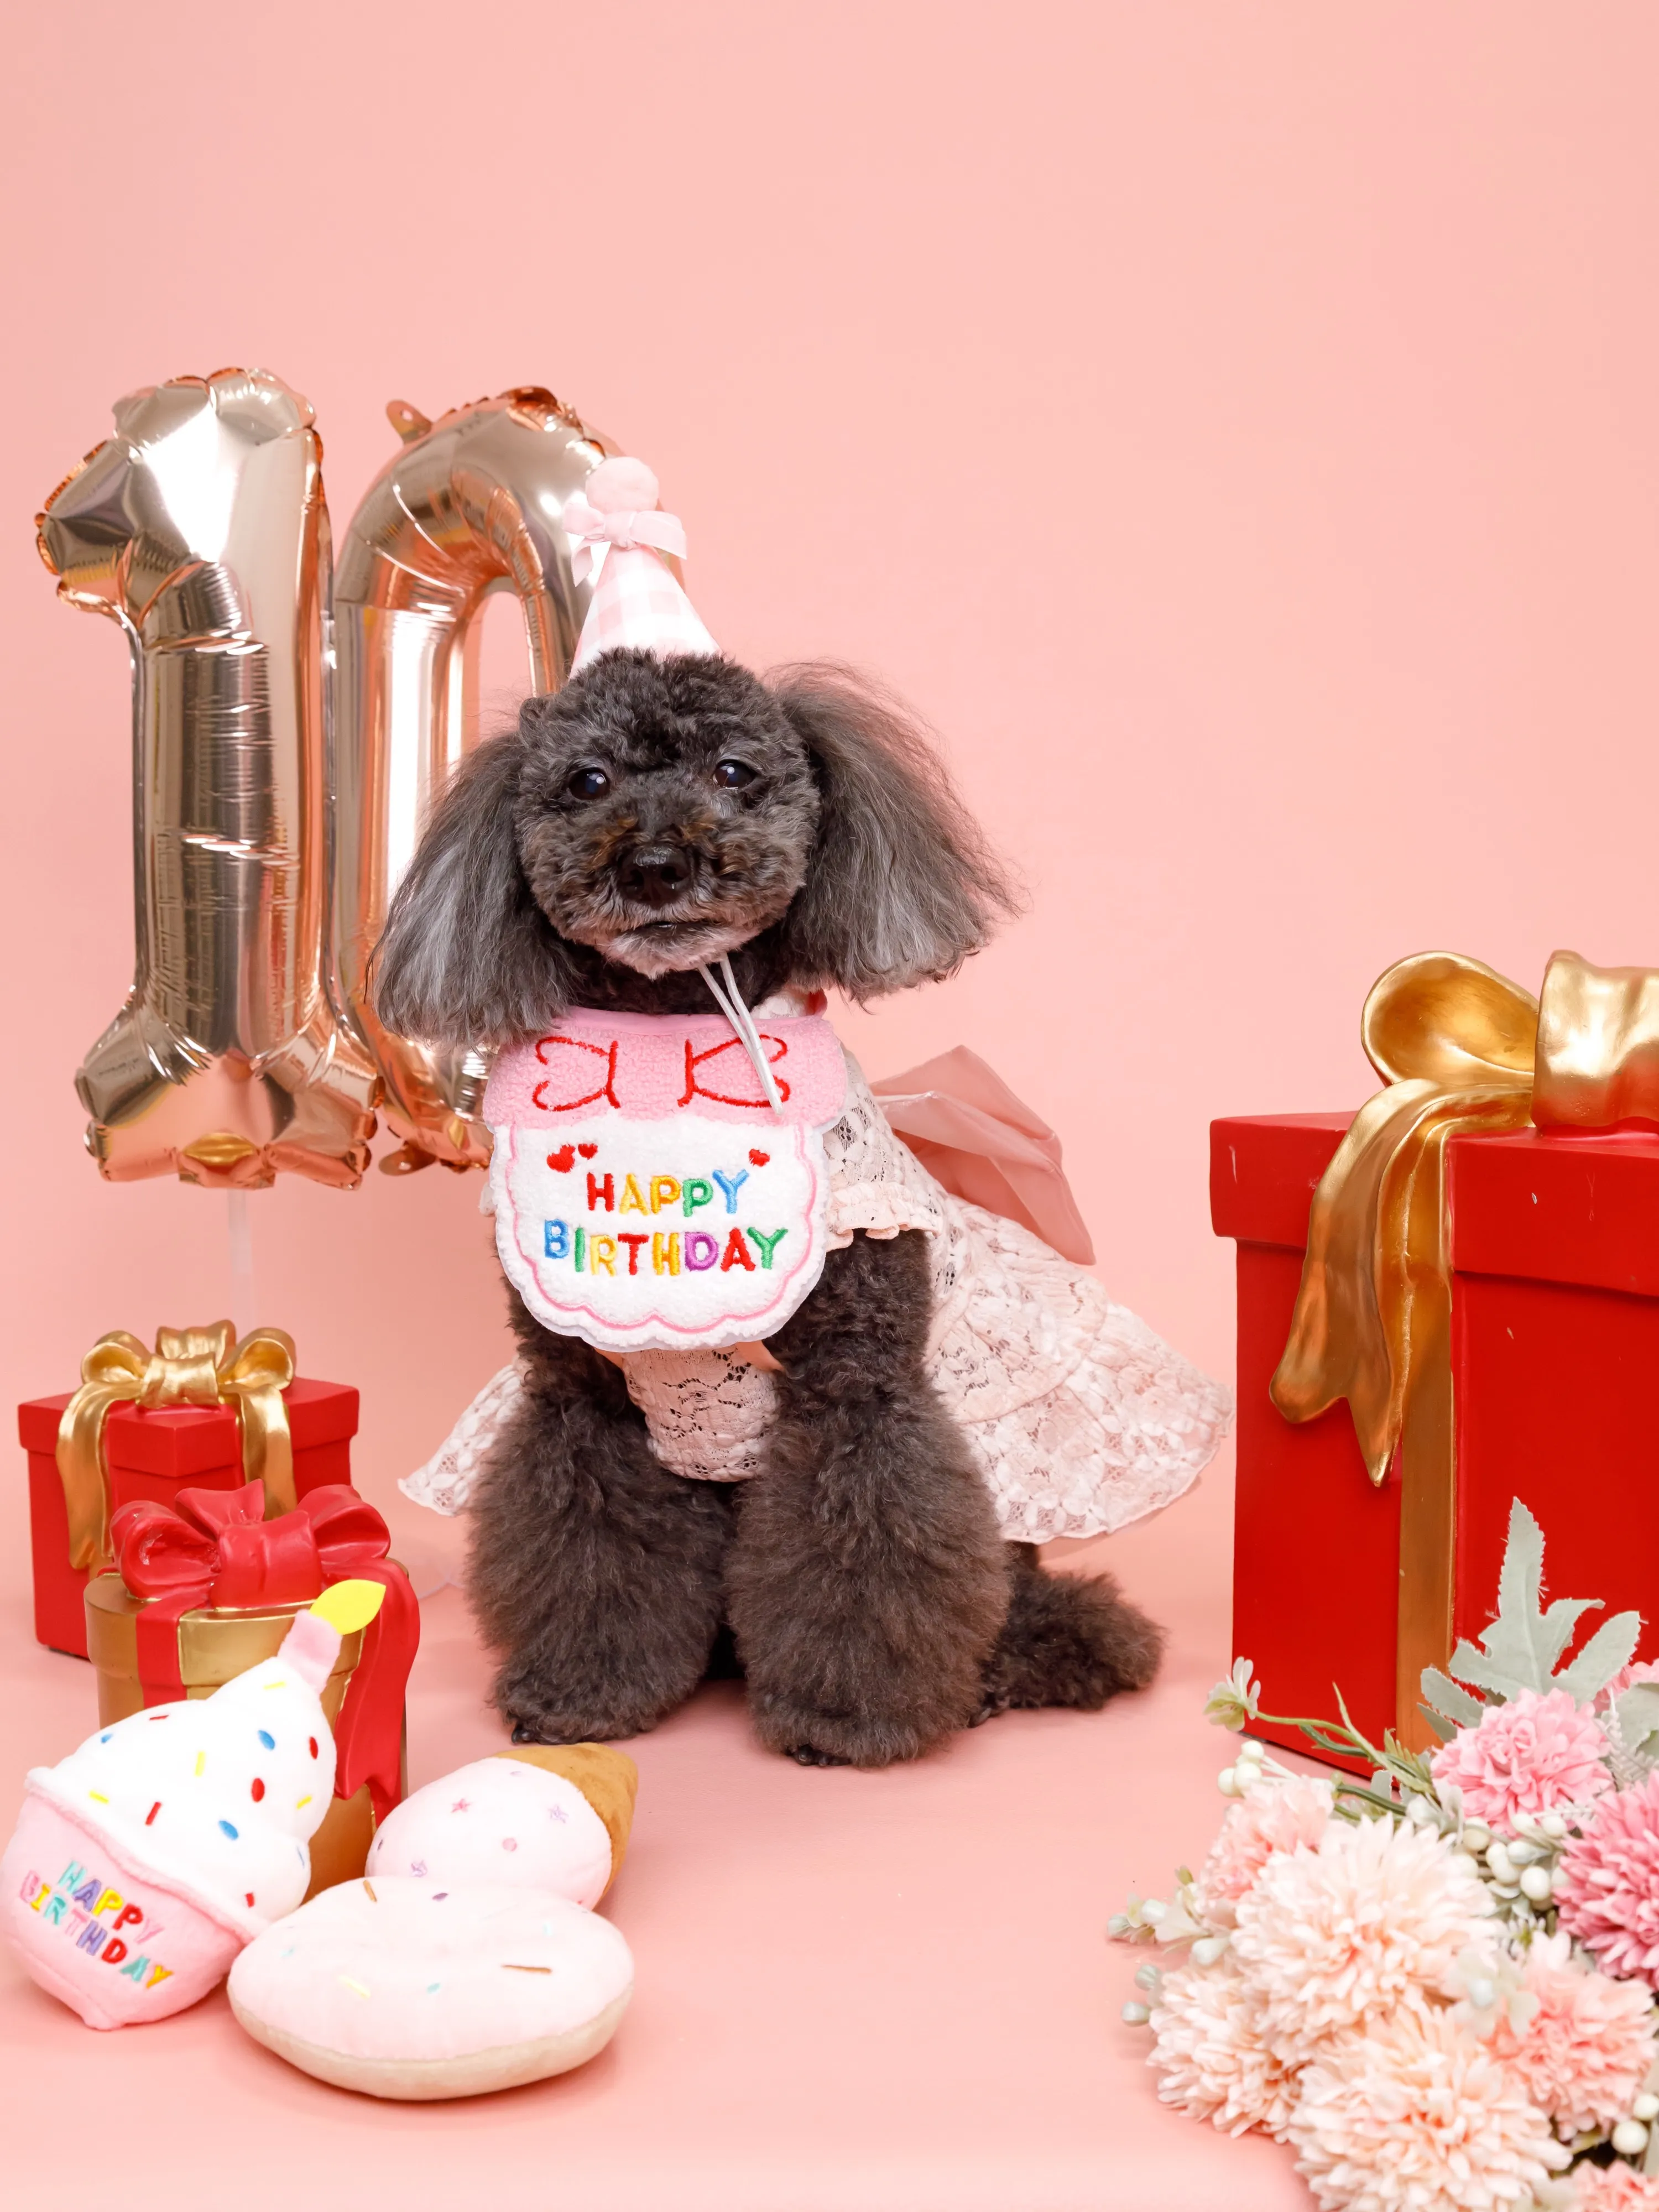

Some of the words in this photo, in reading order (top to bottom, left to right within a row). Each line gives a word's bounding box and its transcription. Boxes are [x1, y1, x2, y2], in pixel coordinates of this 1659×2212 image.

[35, 367, 686, 1191] 10
[586, 1169, 749, 1217] HAPPY
[544, 1218, 788, 1276] BIRTHDAY
[19, 1870, 174, 1989] BIRTHDAY
[57, 1860, 165, 1944] HAPPY
